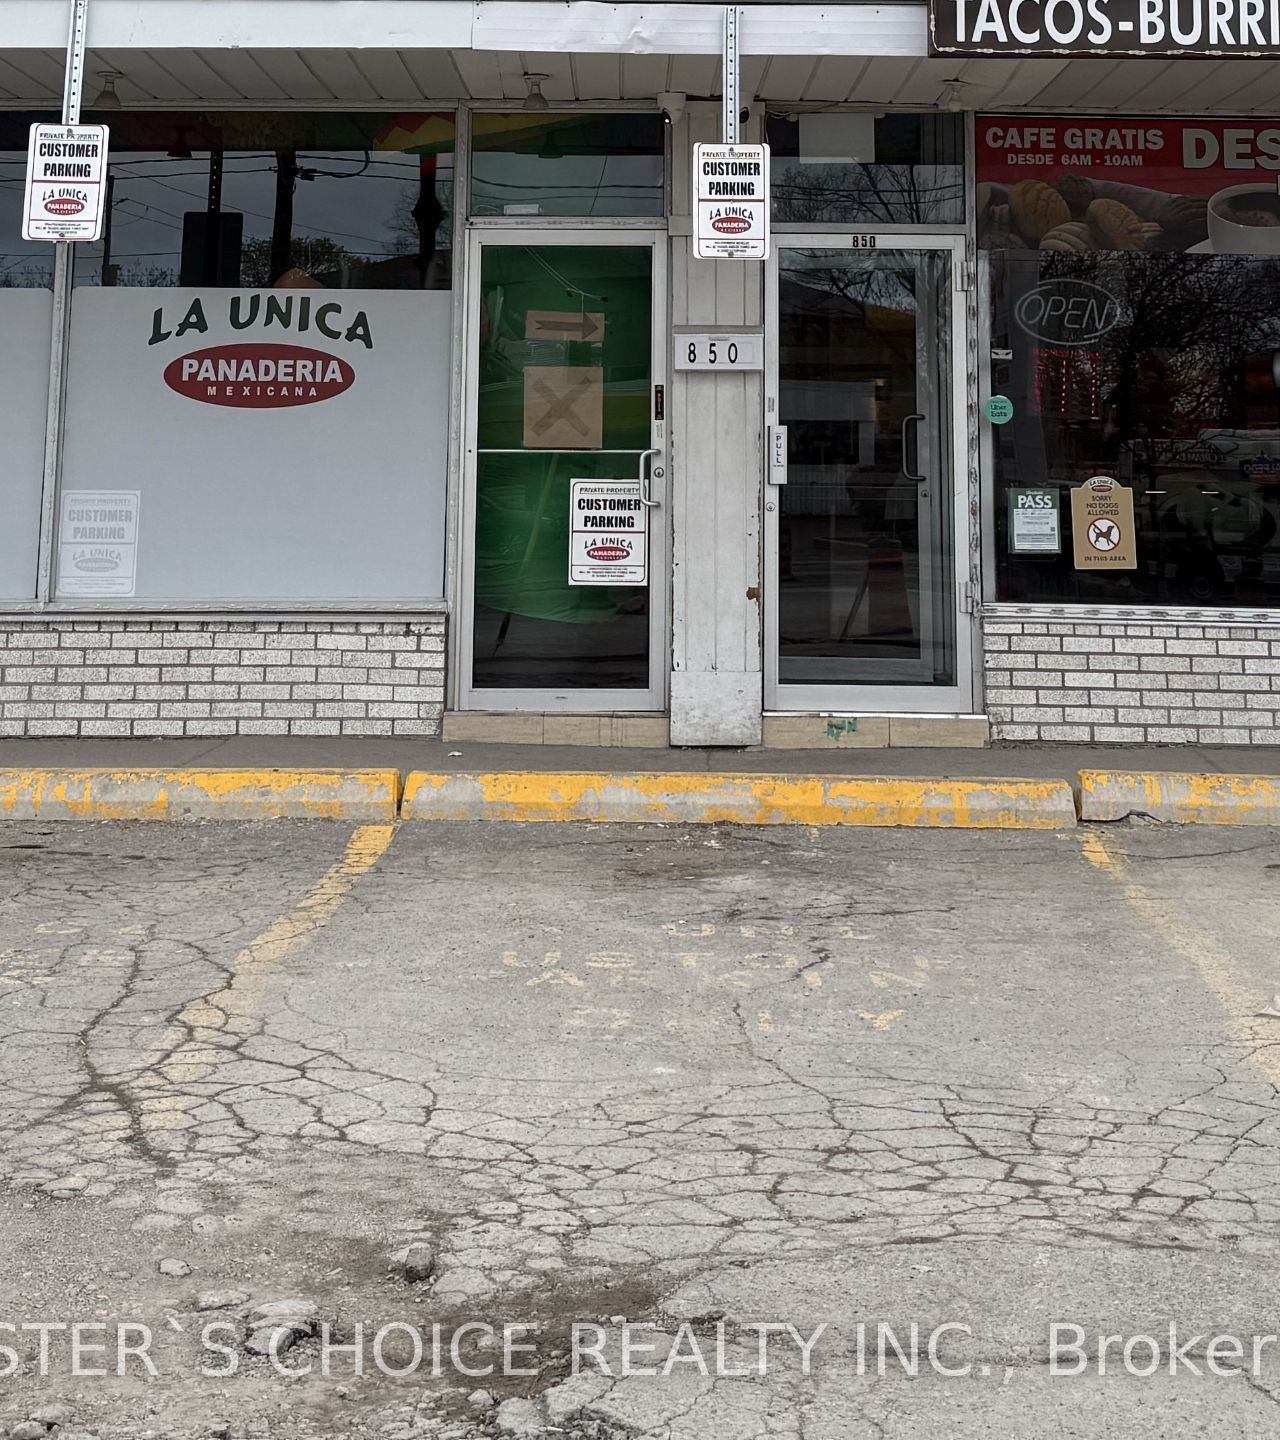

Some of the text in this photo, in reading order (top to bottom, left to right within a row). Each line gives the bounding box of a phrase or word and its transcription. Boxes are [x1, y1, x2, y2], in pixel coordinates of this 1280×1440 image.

[985, 127, 1165, 151] CAFE GRATIS
[40, 143, 98, 158] CUSTOMER
[1007, 153, 1144, 167] DESDE 6AM 10AM
[44, 163, 92, 178] PARKING
[703, 162, 760, 176] CUSTOMER
[42, 188, 88, 202] LA UNICA
[708, 182, 755, 196] PARKING
[710, 207, 754, 222] LA UNICA
[852, 235, 876, 248] 850
[1021, 294, 1111, 329] OPEN
[148, 293, 374, 349] LA UNICA
[687, 342, 738, 364] 850
[181, 359, 344, 383] PANADERIA
[207, 386, 317, 397] MEXICANA
[578, 498, 640, 510] CUSTOMER
[1018, 495, 1052, 508] PASS
[584, 516, 635, 528] PARKING
[584, 537, 633, 550] LA UNICA
